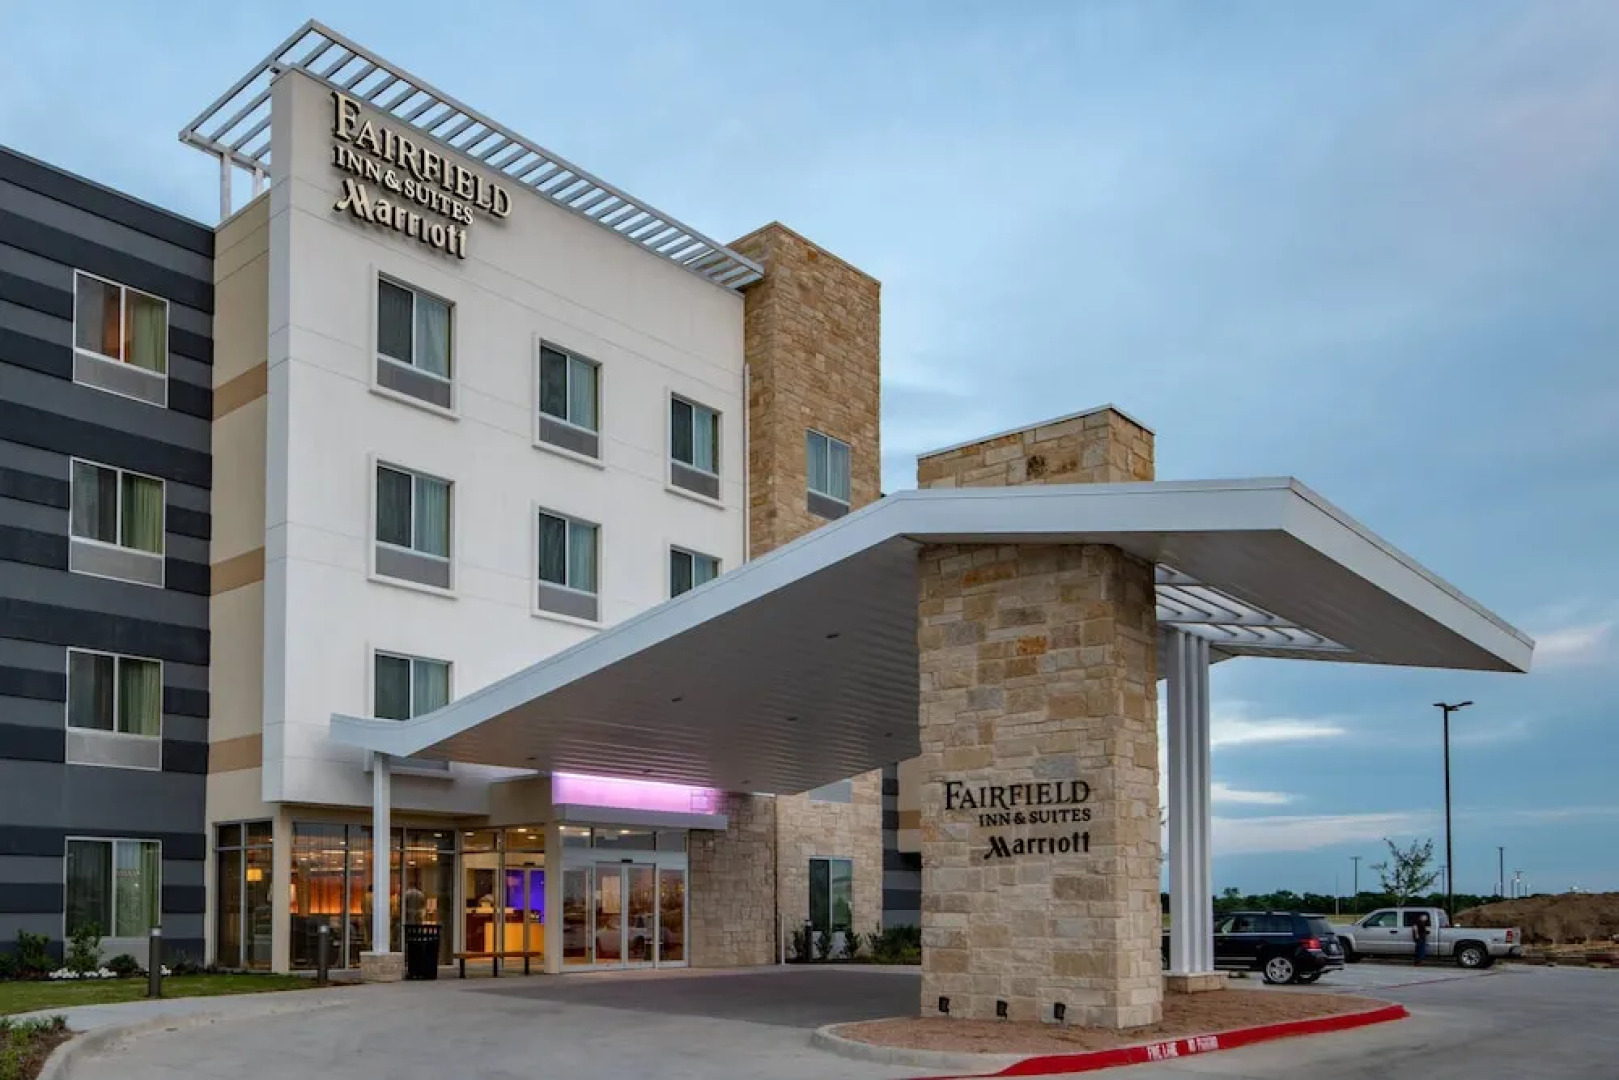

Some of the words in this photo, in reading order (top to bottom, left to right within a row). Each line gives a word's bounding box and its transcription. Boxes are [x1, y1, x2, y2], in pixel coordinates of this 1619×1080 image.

[332, 91, 511, 218] FAIRFIELD
[334, 145, 380, 184] INN
[384, 170, 401, 192] &
[403, 179, 474, 225] SUITES
[334, 178, 466, 259] Marriott
[945, 780, 1090, 810] FAIRFIELD
[978, 812, 1011, 827] INN
[1014, 812, 1027, 825] &
[1029, 808, 1091, 824] SUITES
[984, 831, 1090, 860] Marriott
